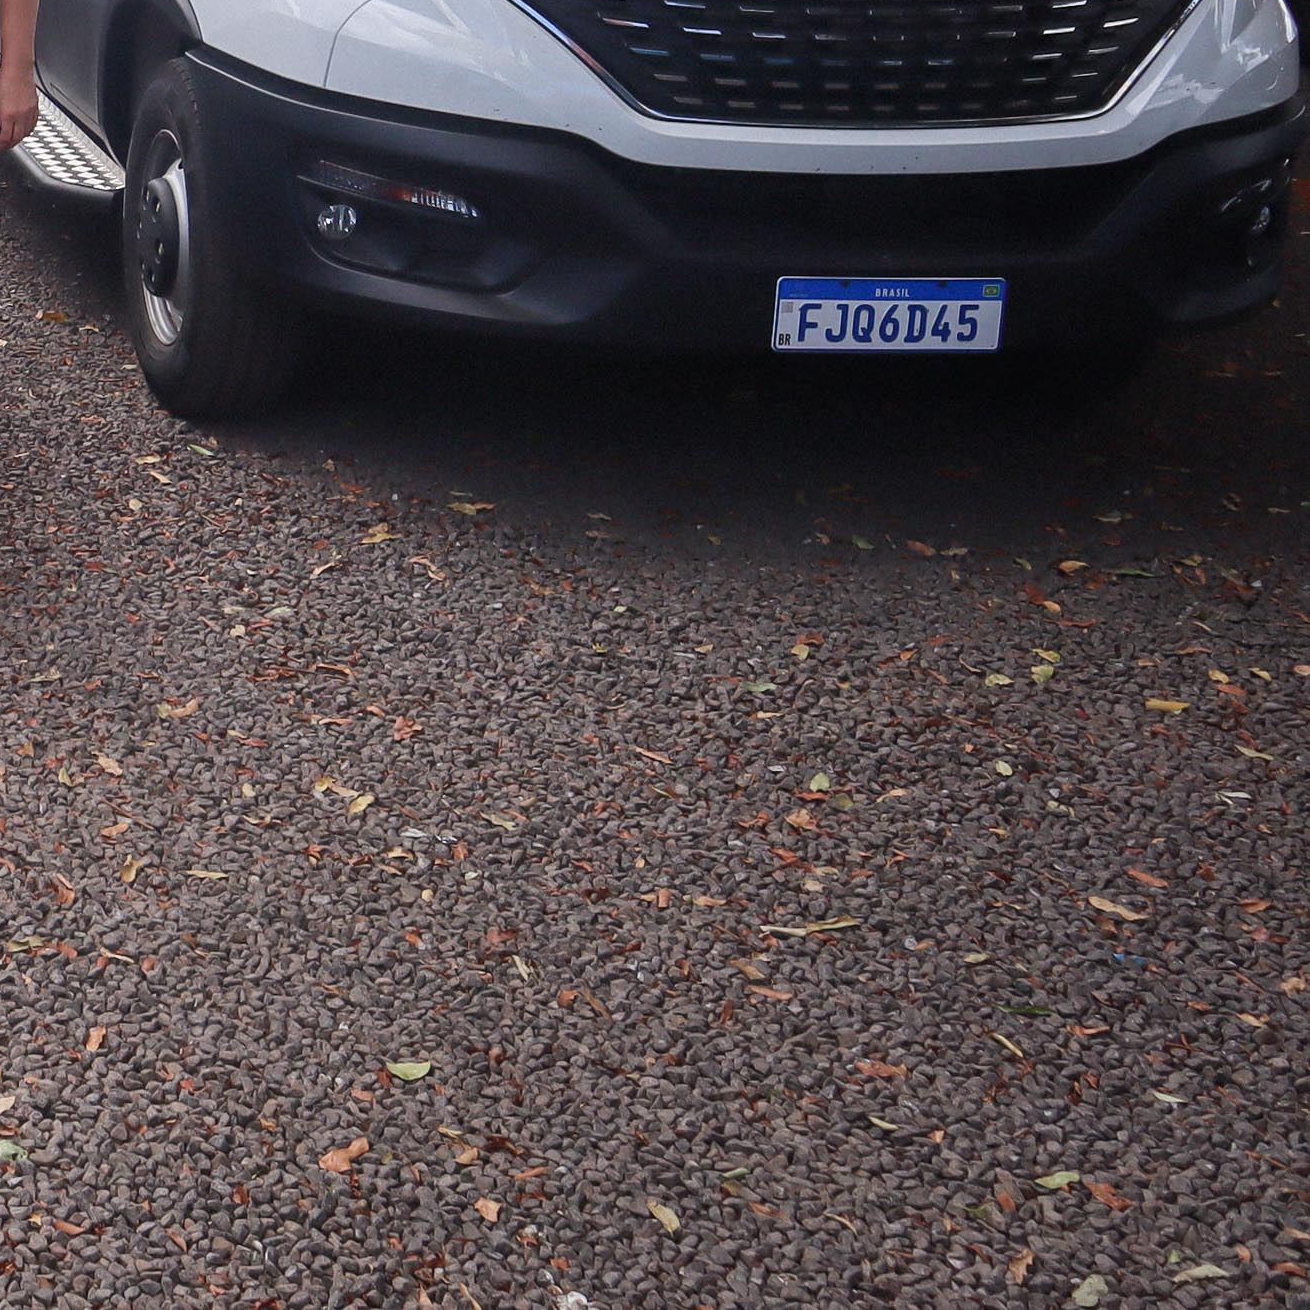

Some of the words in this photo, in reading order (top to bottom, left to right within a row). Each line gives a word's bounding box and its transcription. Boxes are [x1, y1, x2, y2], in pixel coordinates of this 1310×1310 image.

[875, 288, 911, 298] BRASIL
[797, 303, 980, 343] FJQ6D45
[778, 333, 791, 346] BR
